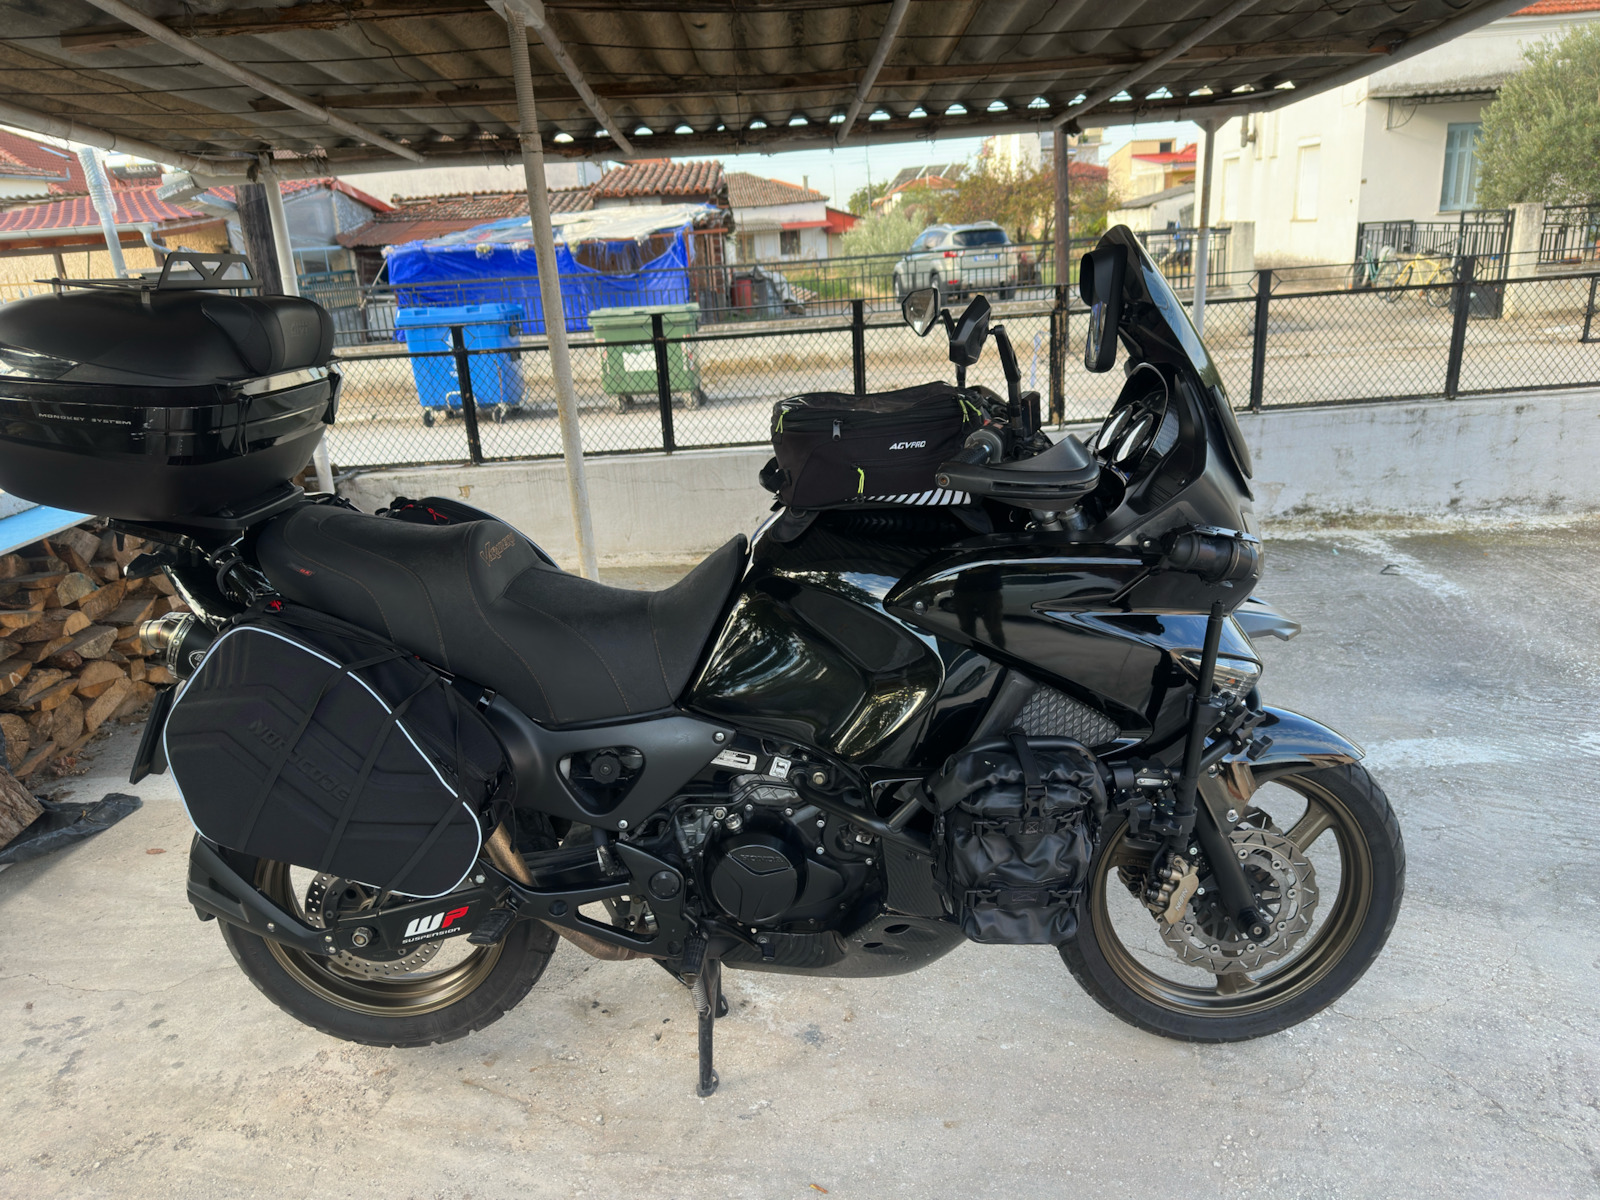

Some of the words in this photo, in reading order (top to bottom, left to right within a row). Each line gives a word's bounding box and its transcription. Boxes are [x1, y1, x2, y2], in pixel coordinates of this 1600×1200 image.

[38, 412, 85, 422] MONOKEY
[889, 440, 926, 450] AGVPRO
[404, 905, 469, 937] WP
[402, 927, 461, 944] SUSPENSION
